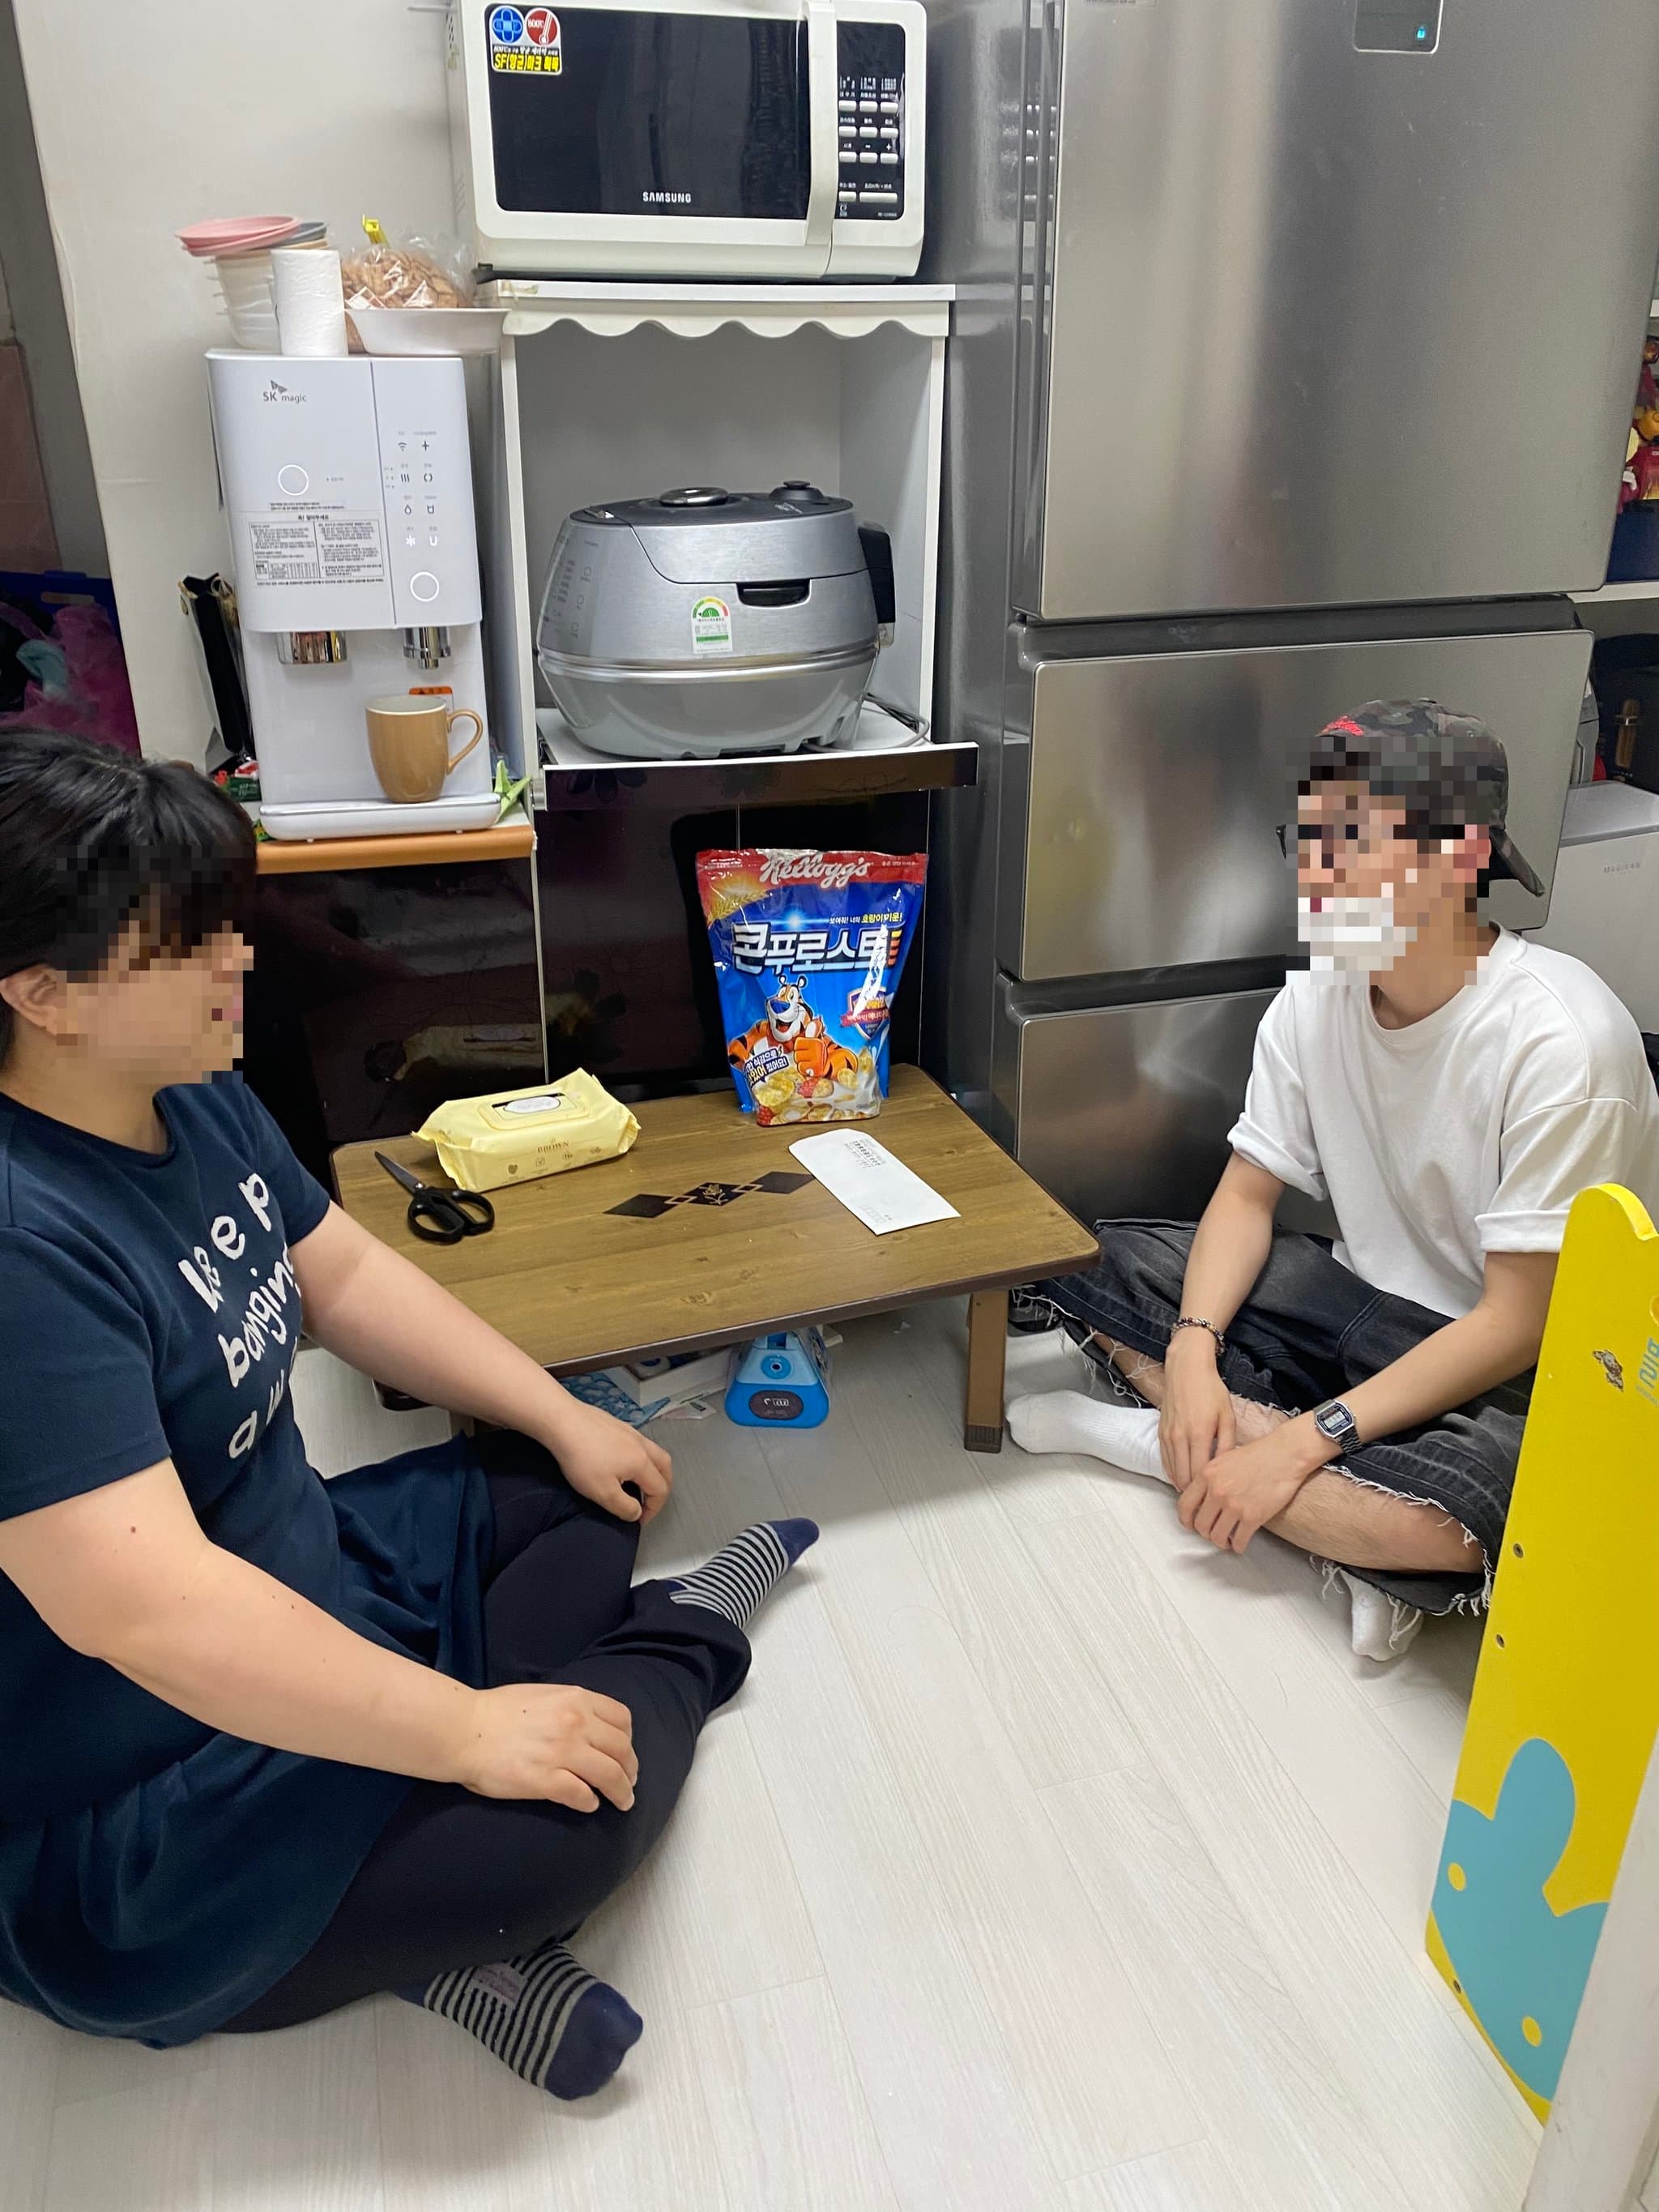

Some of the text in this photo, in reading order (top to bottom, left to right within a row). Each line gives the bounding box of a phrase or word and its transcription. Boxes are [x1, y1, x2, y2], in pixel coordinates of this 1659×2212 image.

[642, 191, 691, 203] SAMSUNG
[262, 391, 307, 404] SK magic
[759, 852, 871, 889] Kellogg's
[861, 913, 883, 924] 호랑이
[732, 923, 902, 975] 콘푸로스트
[537, 1140, 570, 1154] BROWN
